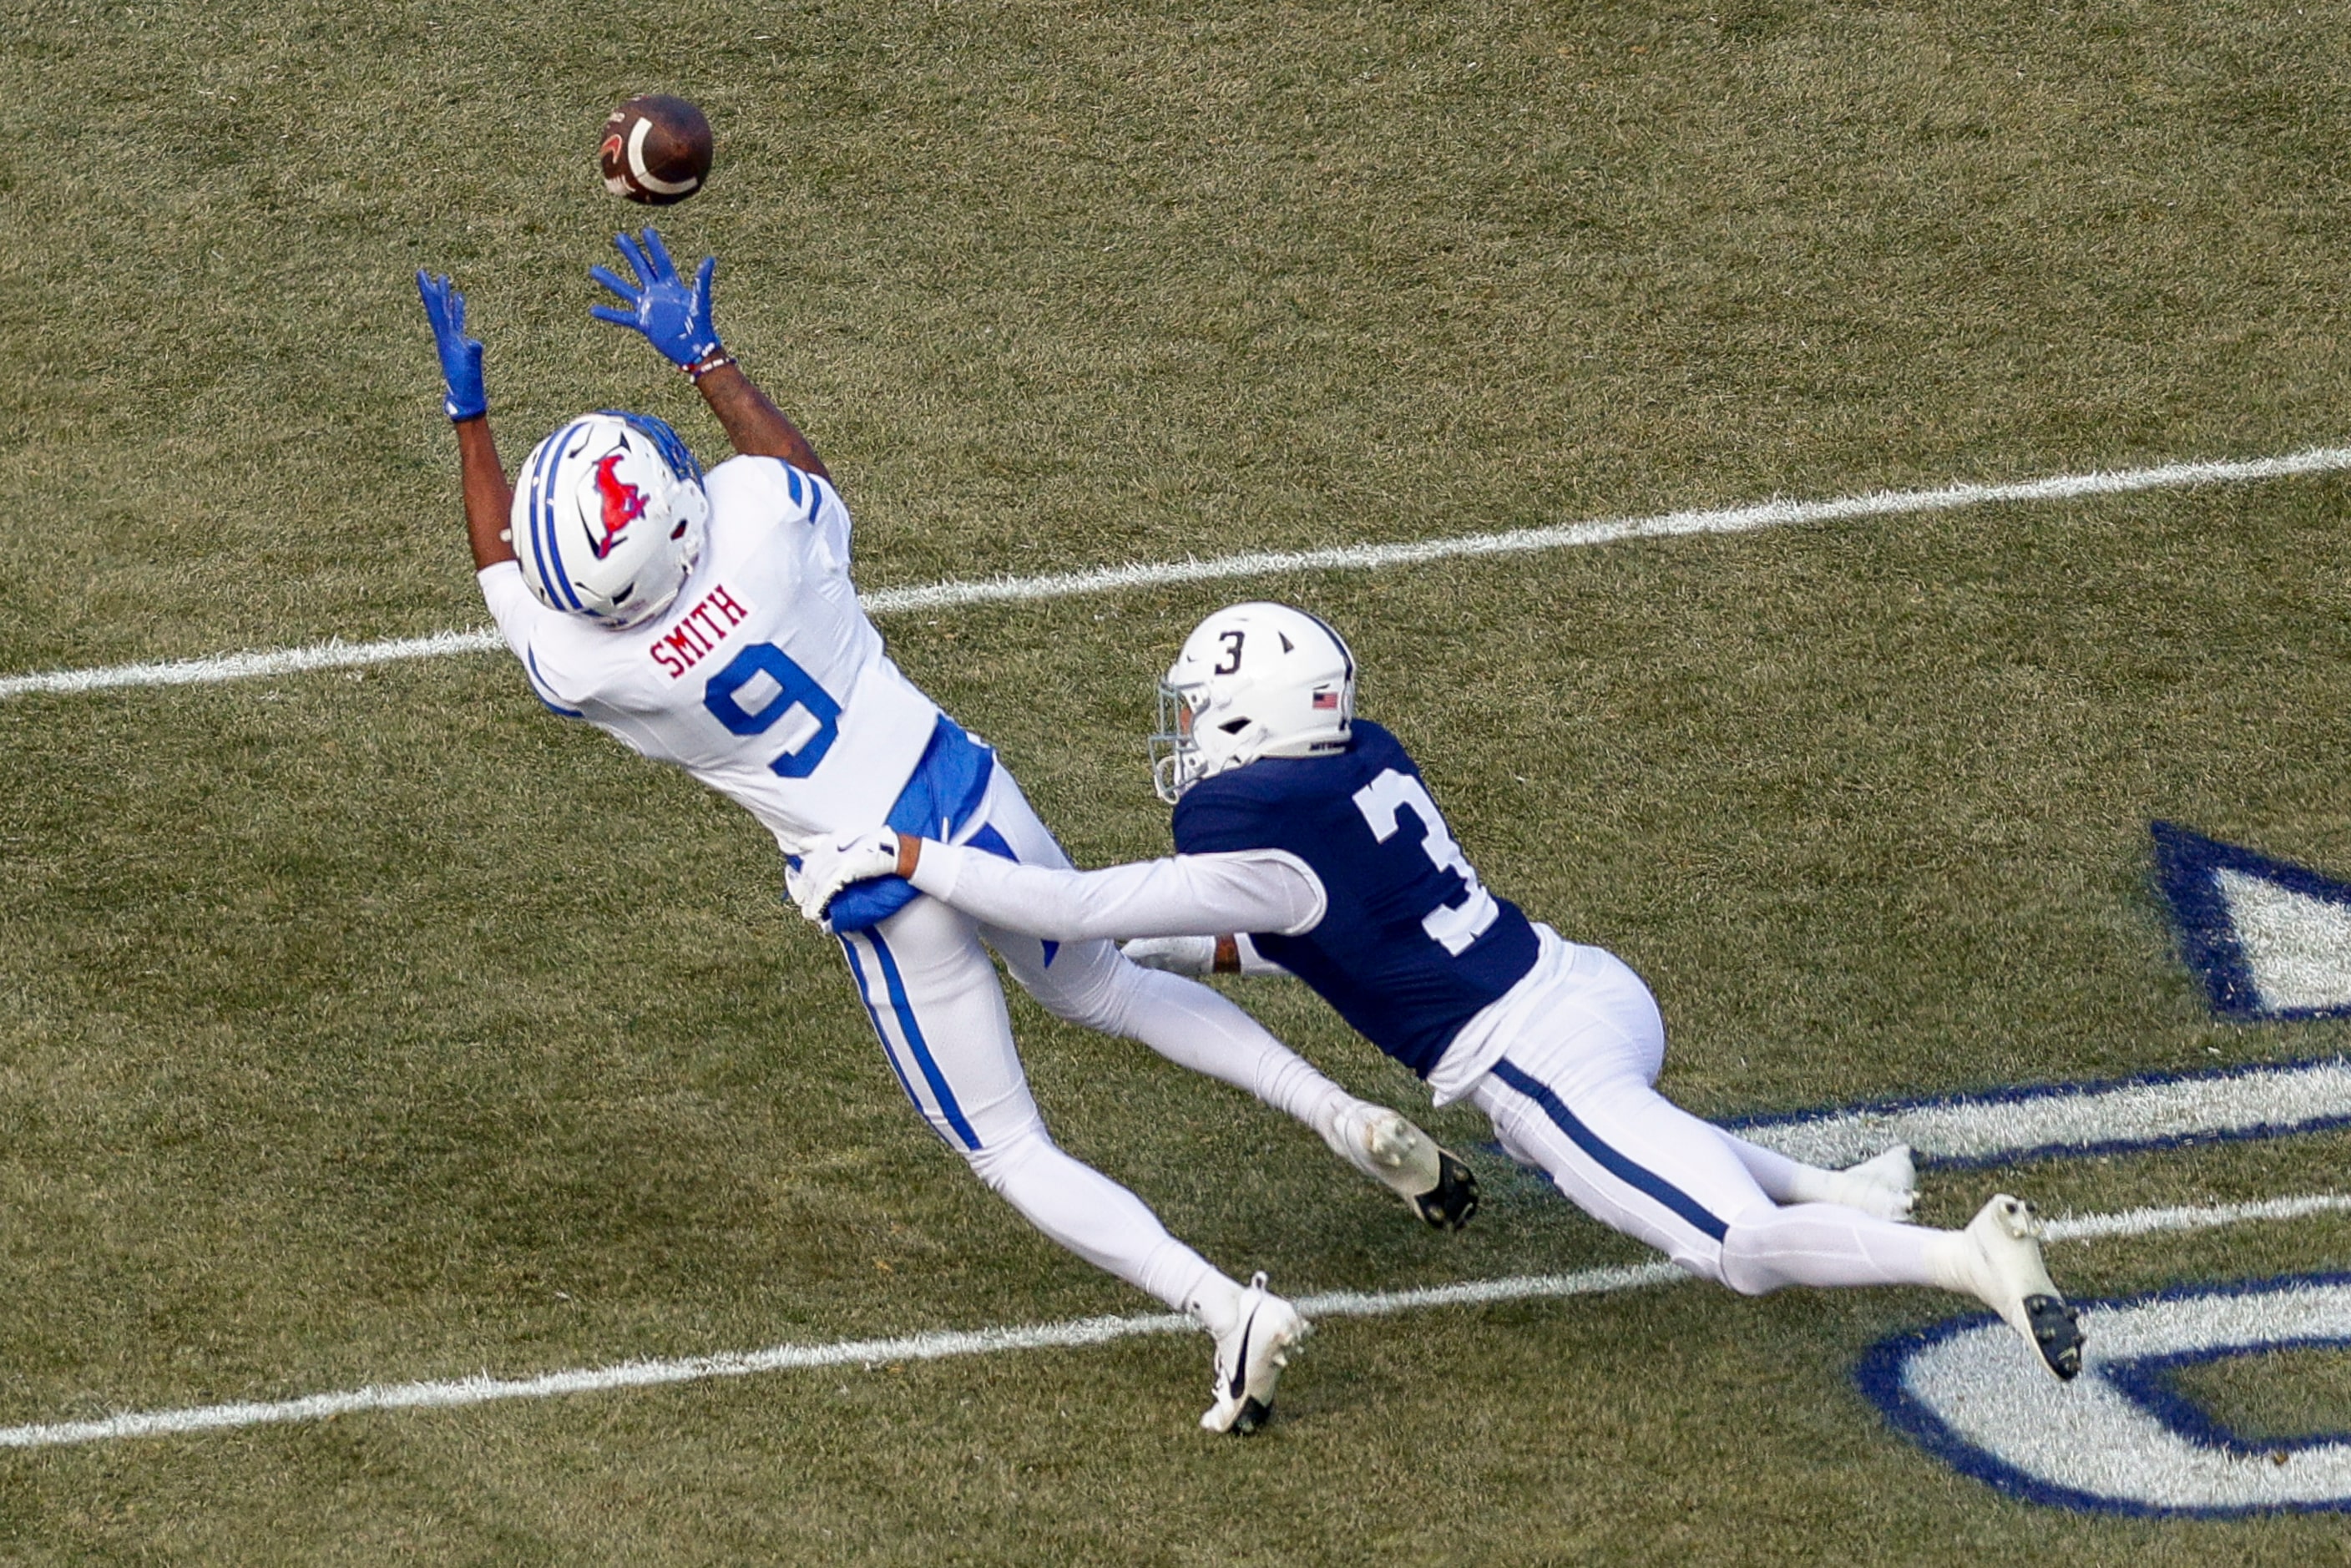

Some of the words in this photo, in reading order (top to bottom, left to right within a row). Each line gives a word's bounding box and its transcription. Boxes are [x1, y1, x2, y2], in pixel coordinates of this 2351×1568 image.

[650, 584, 748, 680] SMITH
[1215, 630, 1245, 675] 3
[703, 642, 842, 778] 9
[1352, 767, 1500, 957] 3
